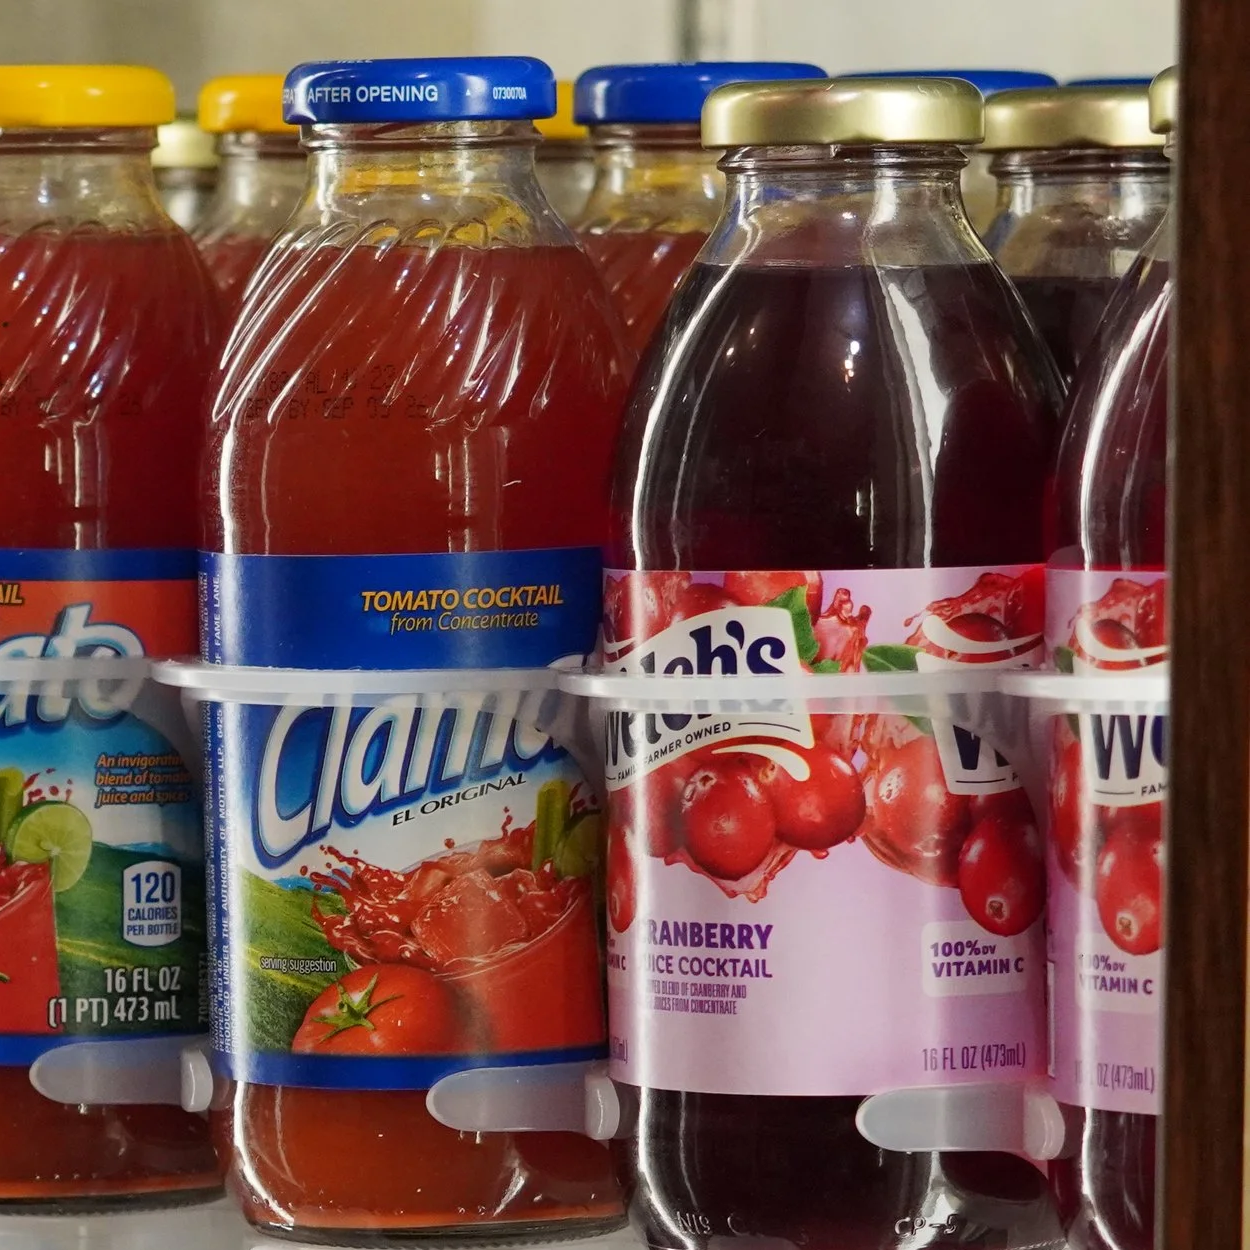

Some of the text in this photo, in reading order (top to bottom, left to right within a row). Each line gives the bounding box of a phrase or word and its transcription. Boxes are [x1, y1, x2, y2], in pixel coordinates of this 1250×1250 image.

[307, 86, 351, 103] AFTER
[355, 85, 439, 103] OPENING
[361, 584, 565, 613] TOMATO COCKTAIL
[213, 612, 222, 646] FAME
[390, 610, 540, 635] from Concentrate
[685, 720, 732, 746] OWNED
[95, 770, 132, 787] blend
[134, 768, 150, 786] of
[94, 788, 128, 809] juice
[130, 787, 155, 804] and
[218, 774, 227, 819] MOTT'S
[391, 772, 528, 827] EL ORIGINAL
[219, 824, 227, 840] OF
[130, 870, 177, 904] 120
[220, 846, 229, 911] AUTHORITY
[127, 906, 178, 922] CALORIES
[126, 922, 179, 937] PER BOTTLE
[221, 915, 229, 939] THE
[645, 919, 774, 950] RANBERRY
[222, 945, 230, 985] UNDER
[259, 956, 337, 975] serving suggestion
[677, 956, 773, 979] COCKTAIL
[931, 956, 1025, 978] VITAMIN C
[104, 966, 182, 994] 16 FL OZ
[690, 982, 730, 999] CRANBERRY
[730, 984, 747, 999] AND
[1142, 978, 1154, 995] C
[75, 998, 108, 1028] PT)
[113, 998, 150, 1023] 473
[154, 996, 182, 1021] mL
[690, 999, 738, 1015] CONCENTRATE
[223, 991, 231, 1054] PRODUCED
[922, 1041, 1027, 1072] 16 FL OZ (473mL)
[1110, 1061, 1155, 1094] (473mL)
